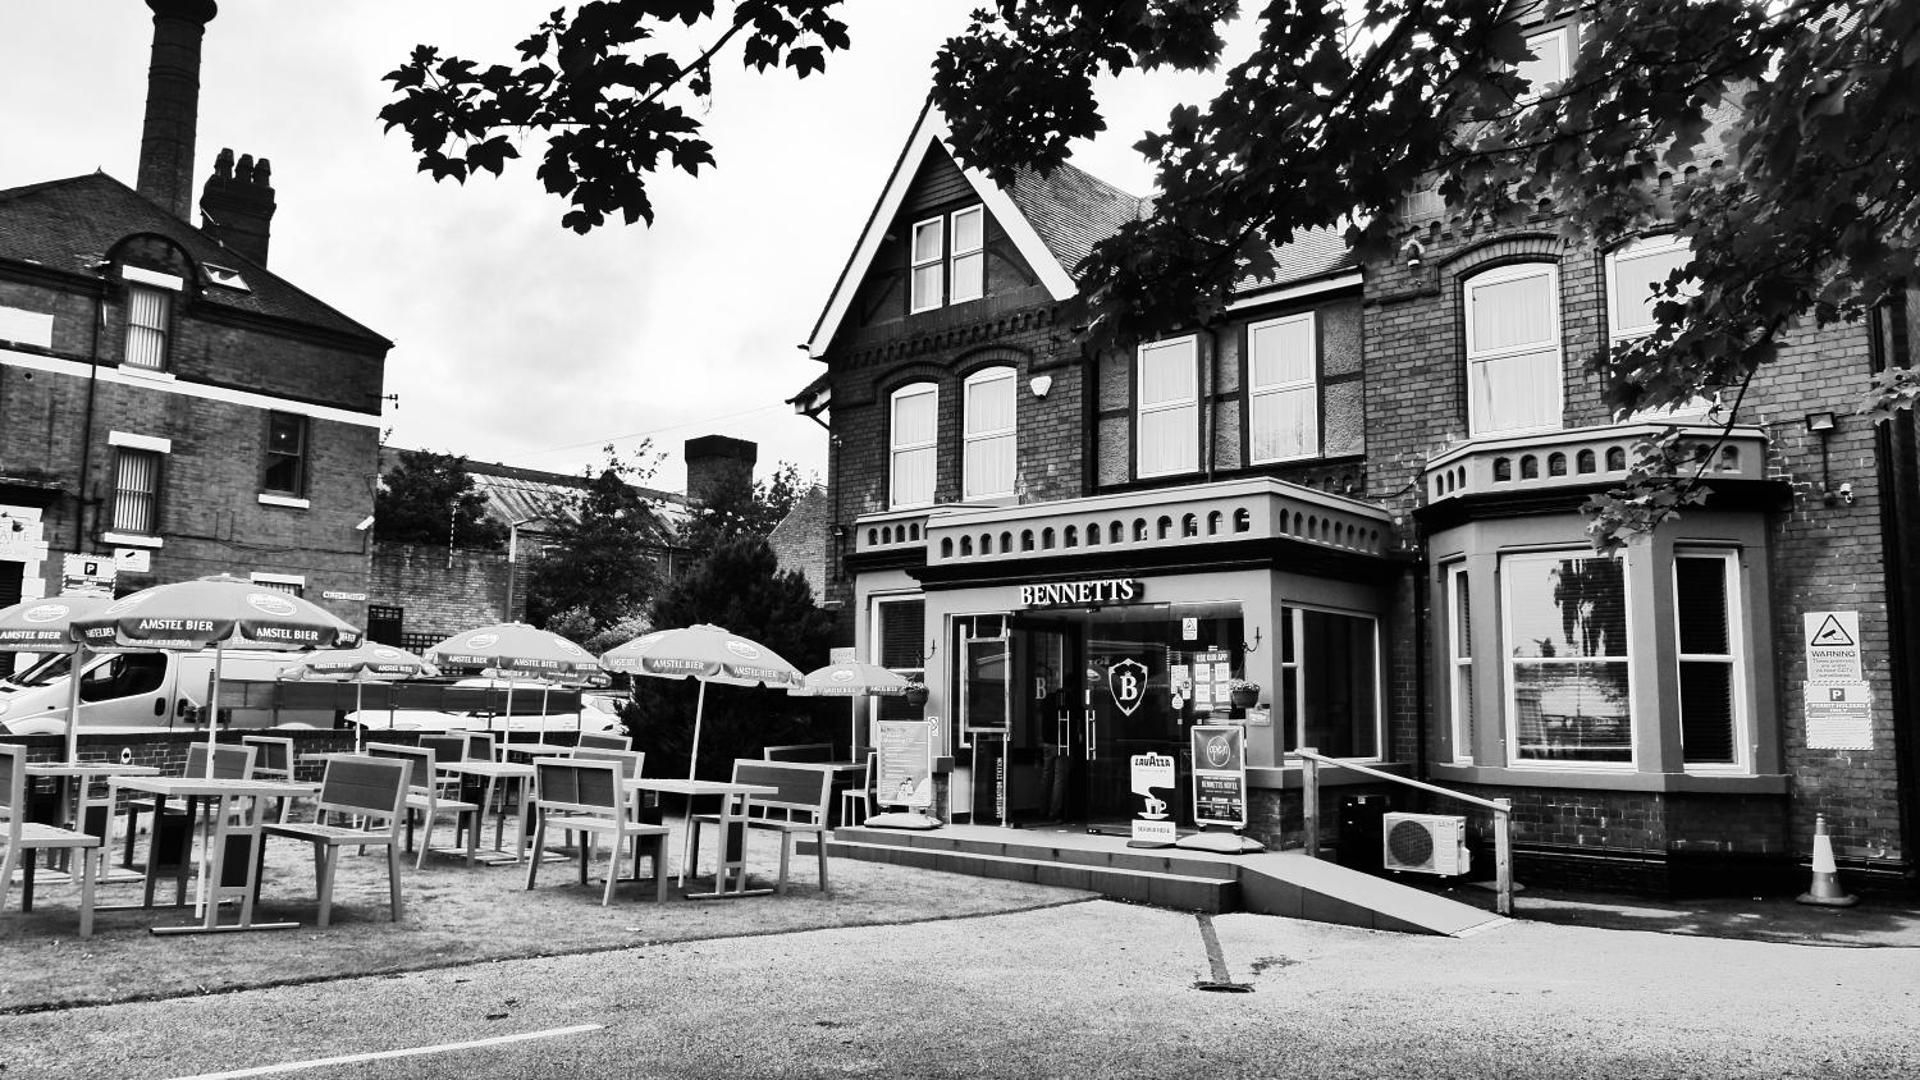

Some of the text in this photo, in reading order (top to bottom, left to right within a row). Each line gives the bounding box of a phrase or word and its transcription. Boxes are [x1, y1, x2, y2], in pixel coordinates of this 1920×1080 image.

[86, 564, 95, 574] P
[1020, 578, 1134, 606] BENNETTS
[139, 619, 213, 631] AMSTEL BIER
[0, 631, 61, 639] AMSTEL BIER
[256, 627, 318, 641] AMSTEL BIER
[1218, 653, 1228, 661] APP
[514, 658, 558, 668] AMSTEL BIER
[653, 659, 704, 670] AMSTEL BIER
[734, 667, 777, 678] AMSTEL BIER
[1035, 677, 1046, 700] B
[1120, 675, 1138, 700] B
[1832, 689, 1842, 700] P
[1135, 756, 1171, 767] LAVAZZA
[1201, 780, 1239, 790] BENNETTS HOTEL
